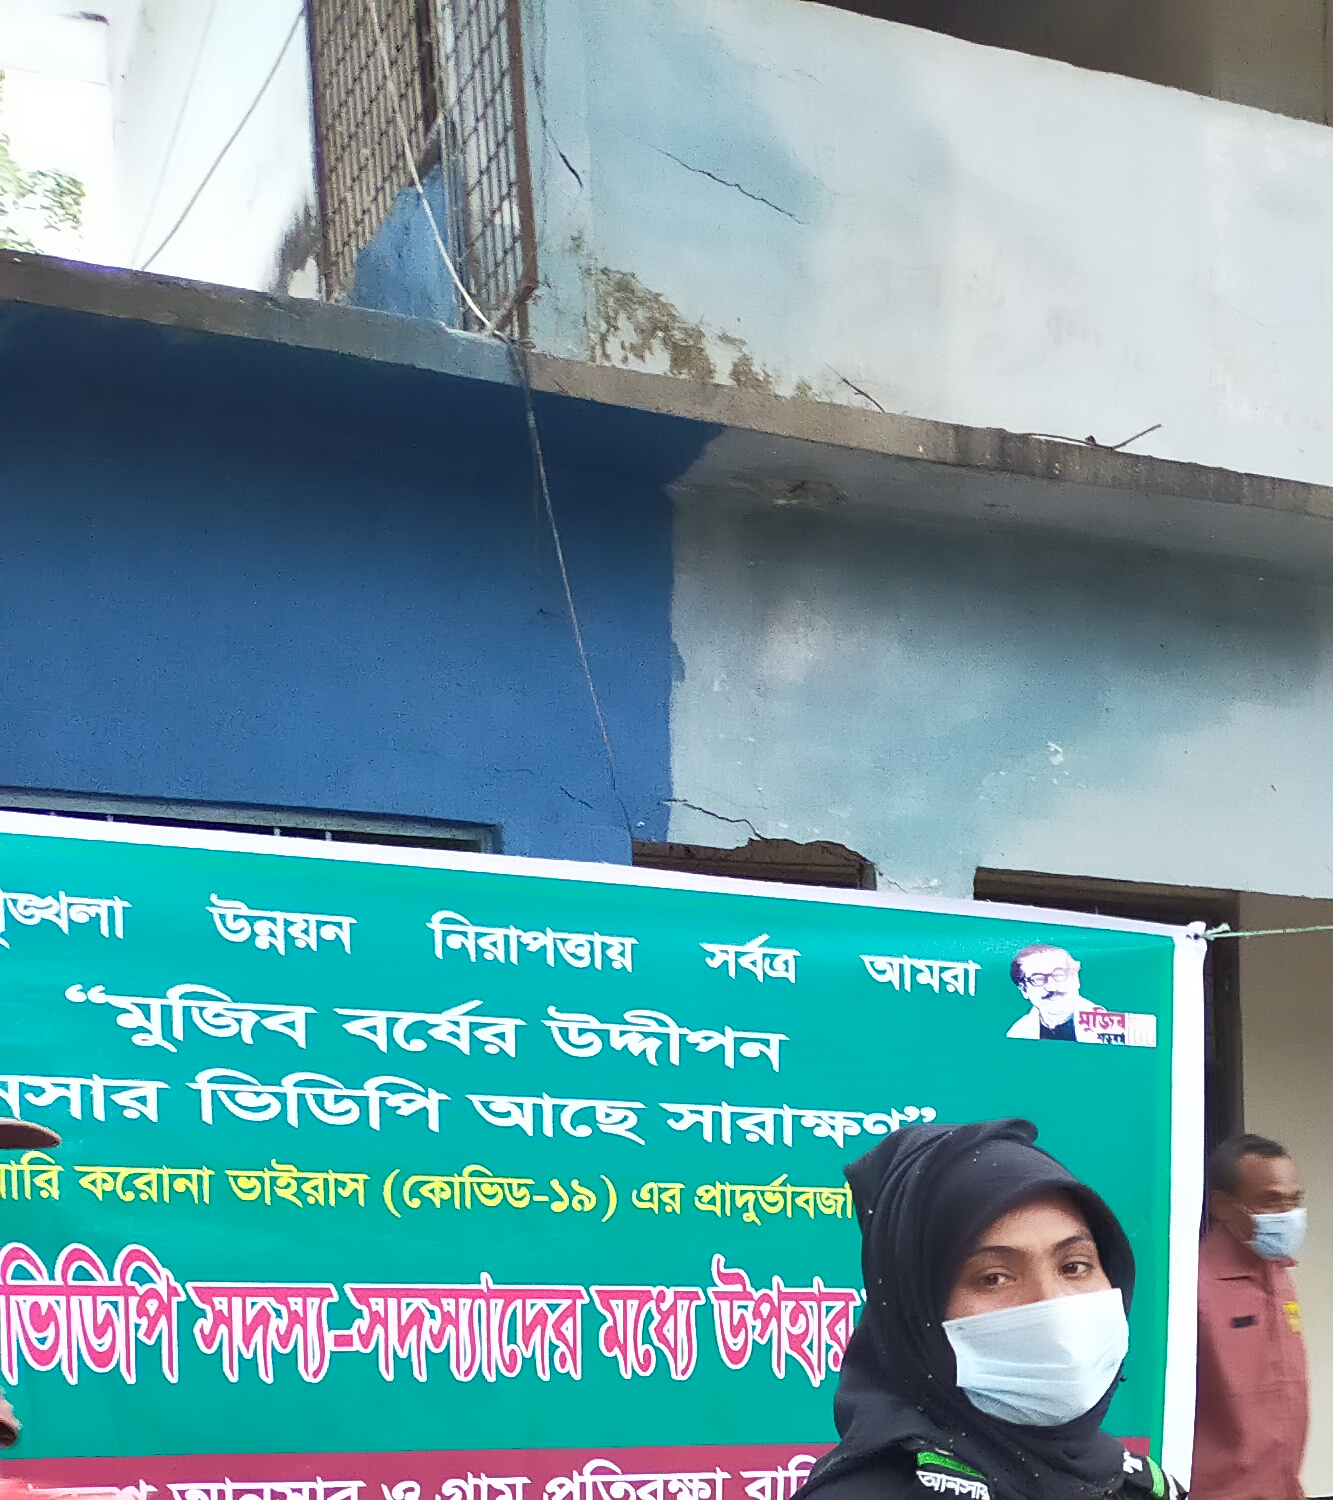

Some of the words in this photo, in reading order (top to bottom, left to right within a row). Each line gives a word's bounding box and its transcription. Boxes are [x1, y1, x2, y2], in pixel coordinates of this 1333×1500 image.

[205, 893, 357, 956] উন্নয়ন
[427, 910, 639, 973] নিরাপত্তায়
[700, 933, 801, 984] সর্বত্র
[860, 954, 982, 997] আমরা
[333, 1000, 525, 1058] বর্ষের
[541, 1005, 790, 1072] উদ্দীপন
[1079, 1006, 1125, 1032] মুজিব
[186, 1067, 451, 1133] ভিডিপি
[466, 1092, 647, 1145] আছে
[73, 1163, 216, 1206] করোনা
[225, 1159, 371, 1208] ভাইরাস
[632, 1181, 685, 1215] এর
[0, 1241, 185, 1387] ভিডিপি
[595, 1284, 707, 1382] মধ্যে
